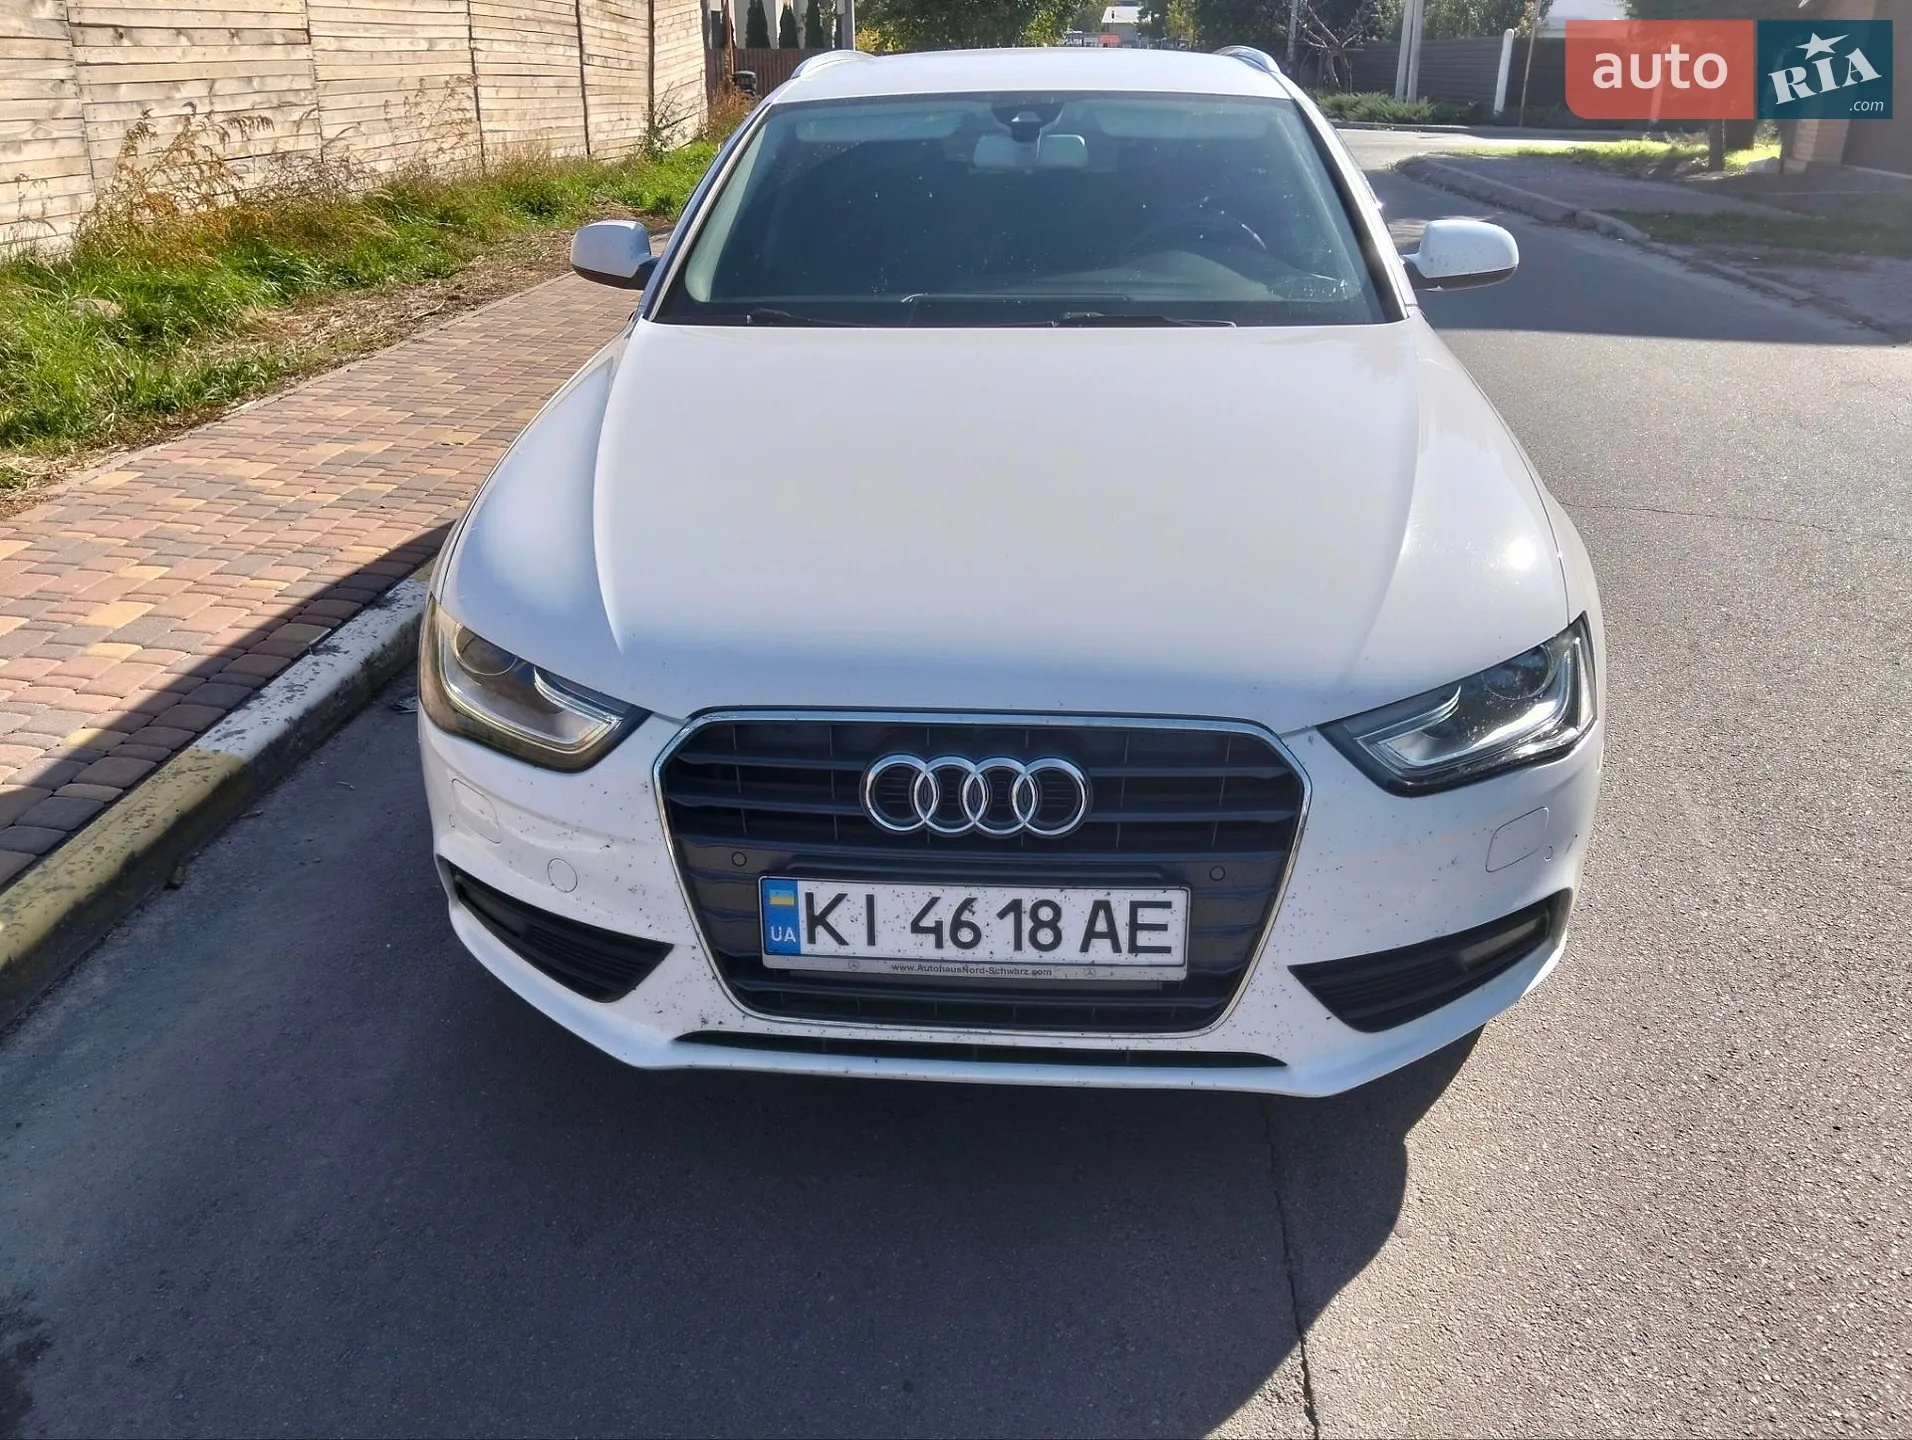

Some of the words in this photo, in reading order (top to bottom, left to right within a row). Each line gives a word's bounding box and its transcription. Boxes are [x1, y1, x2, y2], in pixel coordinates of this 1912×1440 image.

[770, 925, 797, 942] UA
[805, 891, 876, 947] KI
[910, 896, 1062, 952] 4618
[1079, 899, 1173, 954] AE
